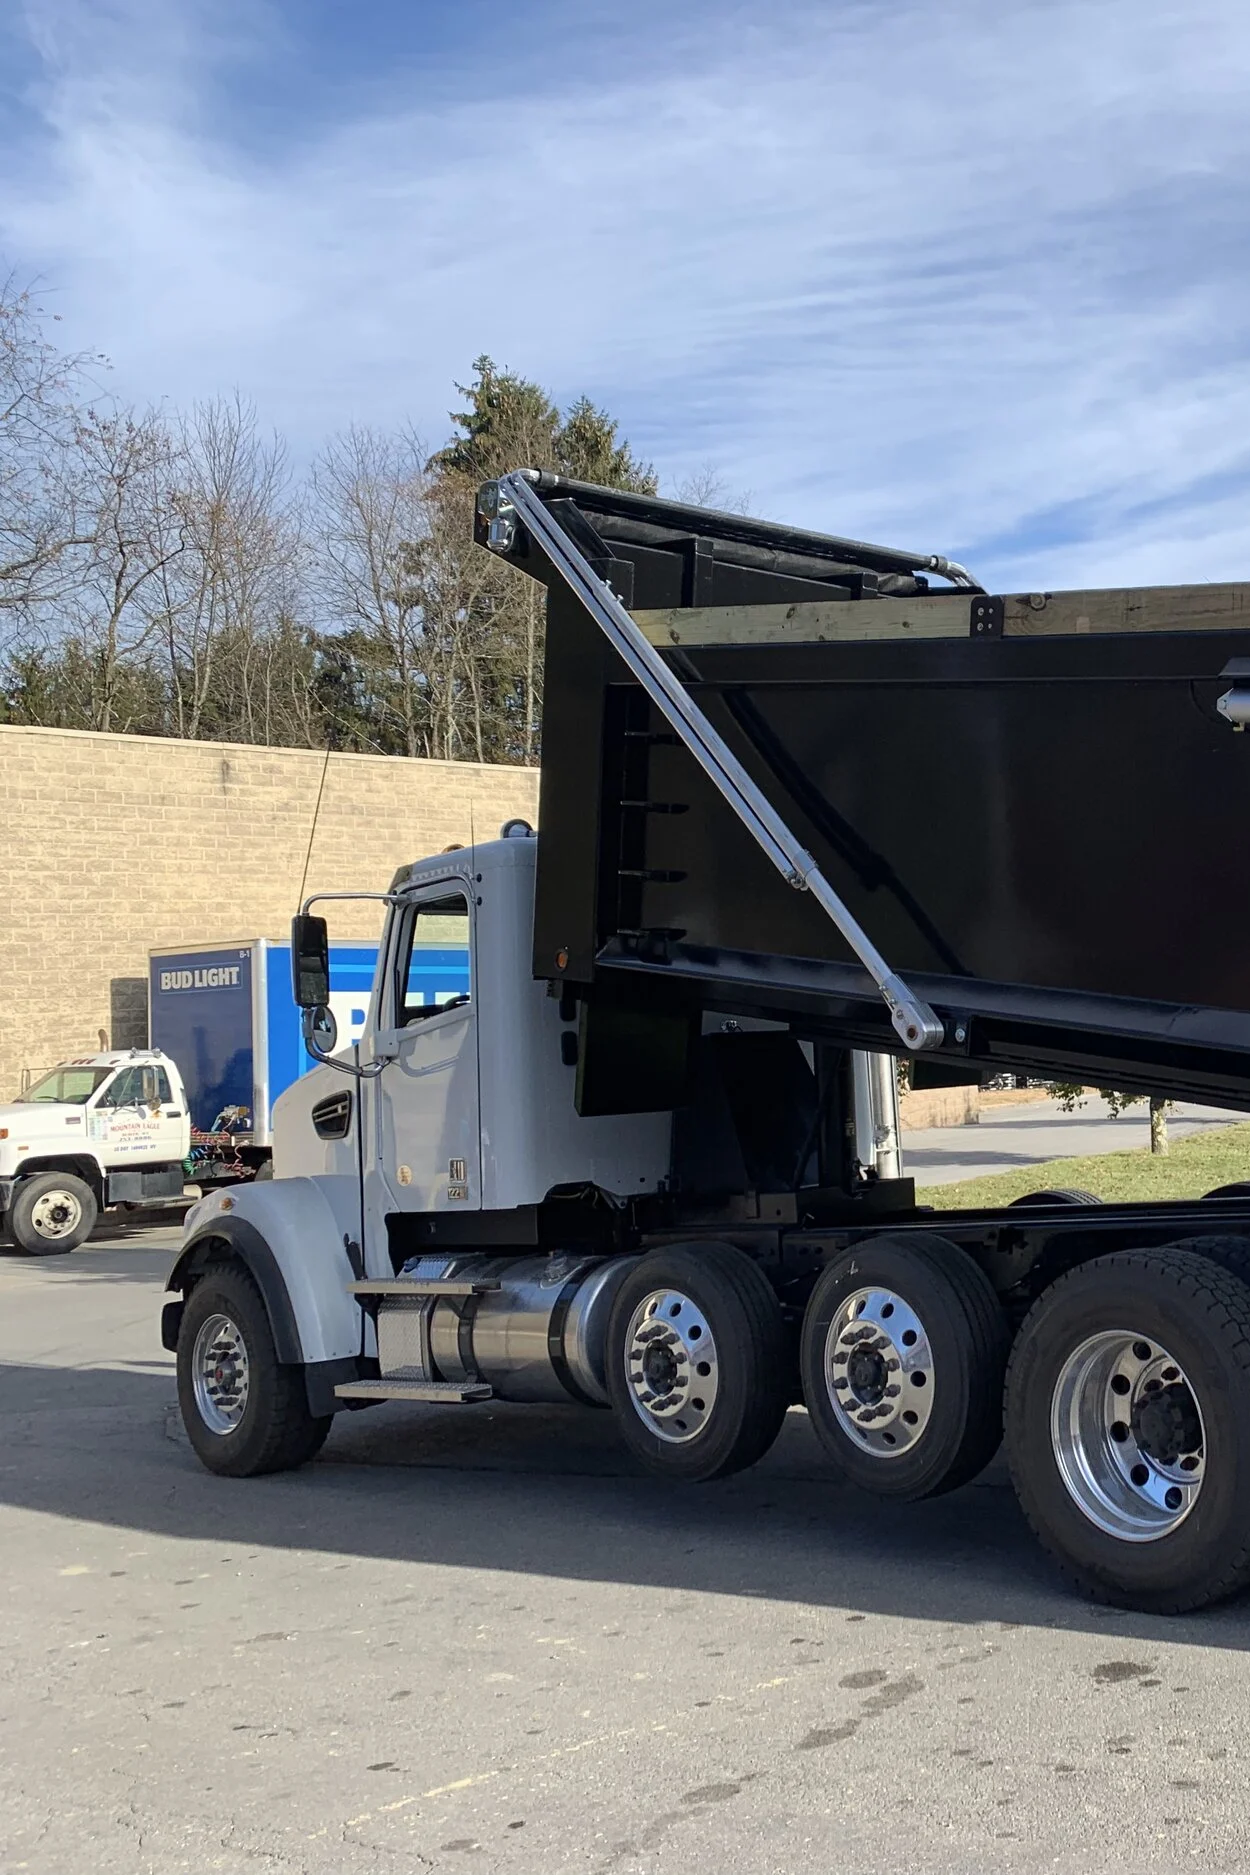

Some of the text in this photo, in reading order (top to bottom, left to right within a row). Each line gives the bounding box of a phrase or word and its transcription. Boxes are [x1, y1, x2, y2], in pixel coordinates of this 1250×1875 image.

[160, 966, 240, 990] BUD LIGHT
[110, 1123, 141, 1131] MOUNTAIN
